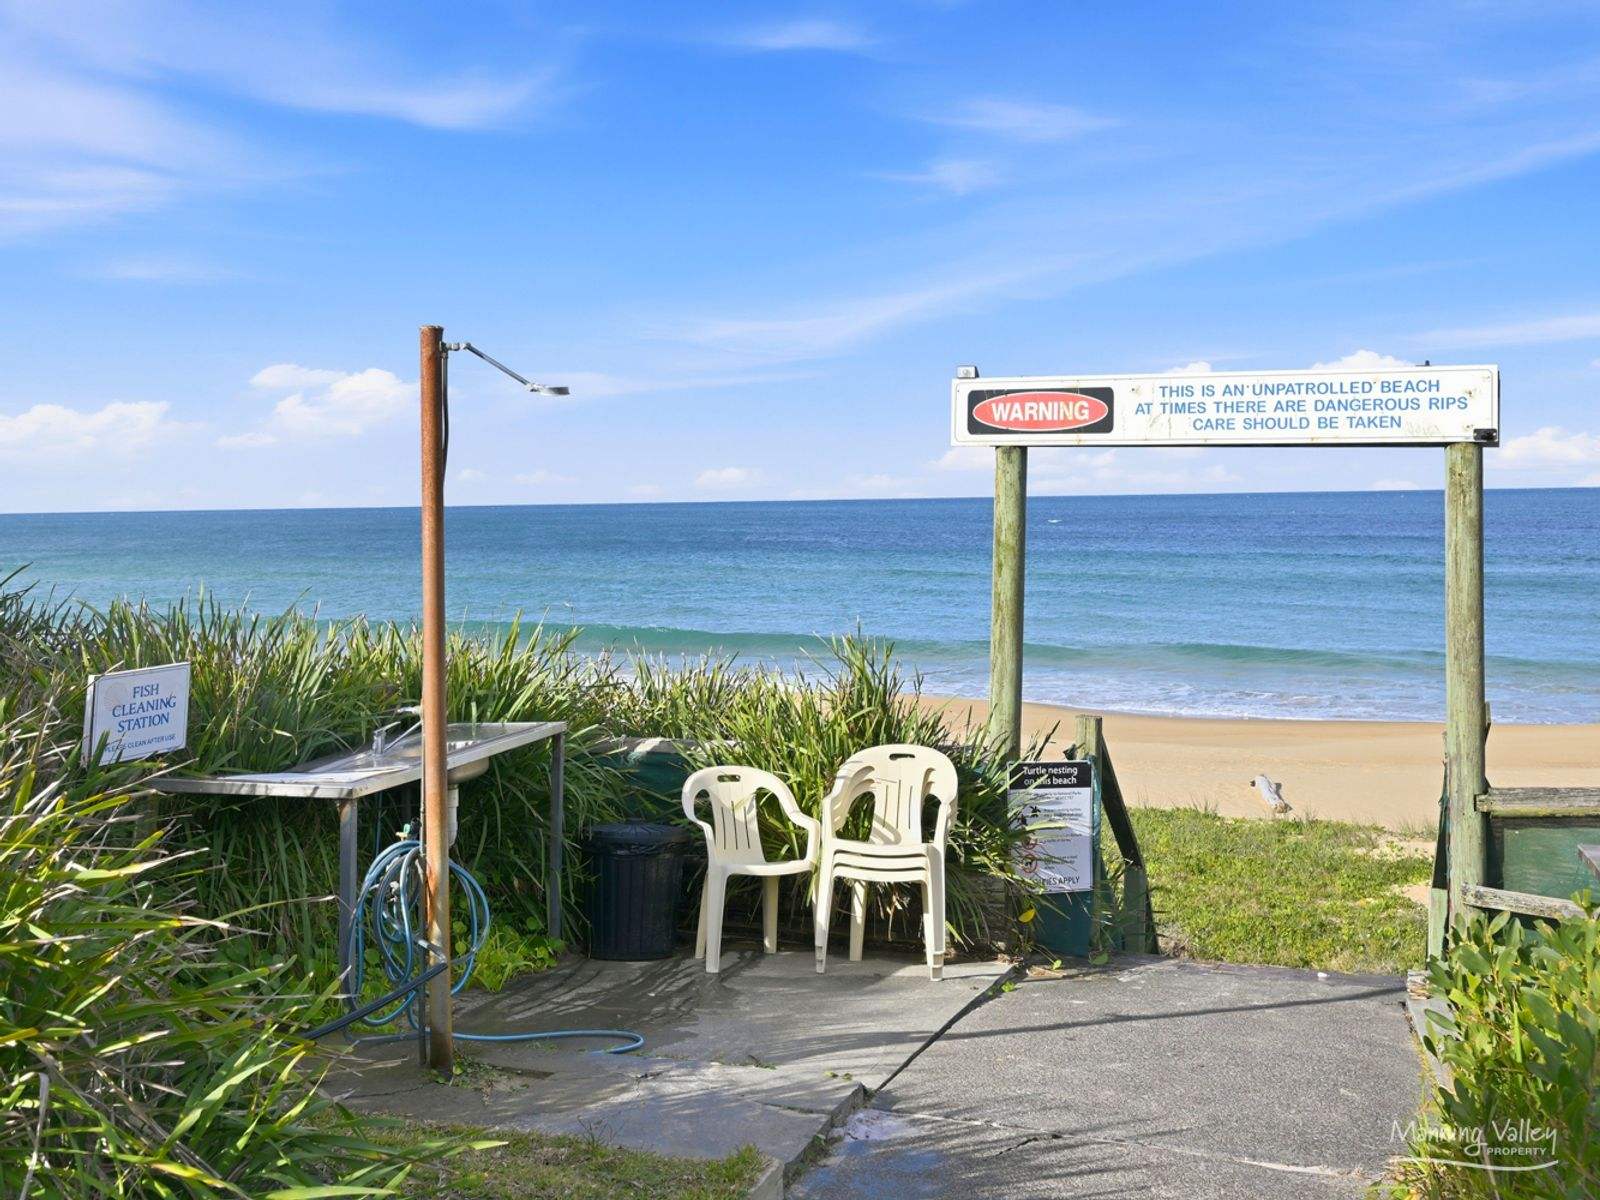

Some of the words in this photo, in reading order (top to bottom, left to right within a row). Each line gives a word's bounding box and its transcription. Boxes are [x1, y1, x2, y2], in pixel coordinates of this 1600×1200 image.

[1159, 384, 1195, 398] THIS
[1201, 384, 1215, 396] IS
[1222, 384, 1245, 396] AN
[1252, 381, 1373, 396] UNPATROLLED
[1381, 380, 1440, 393] BEACH
[991, 400, 1090, 421] WARNING
[1135, 402, 1153, 415] AT
[1159, 401, 1206, 414] TIMES
[1215, 400, 1266, 413] THERE
[1273, 400, 1306, 412] ARE
[1314, 397, 1420, 412] DANGEROUS
[1428, 396, 1468, 410] RIPS
[1192, 417, 1235, 430] CARE
[1242, 417, 1310, 430] SHOULD
[1317, 417, 1339, 429] BE
[1347, 415, 1401, 428] TAKEN
[133, 683, 159, 698] FISH
[112, 695, 176, 717] CLEANING
[117, 712, 170, 733] STATION
[127, 740, 146, 748] CLEAN
[1023, 766, 1047, 774] Turtle
[1048, 766, 1078, 776] nesting
[1024, 778, 1034, 786] on
[1053, 776, 1077, 784] beach
[1058, 876, 1080, 885] APPLY
